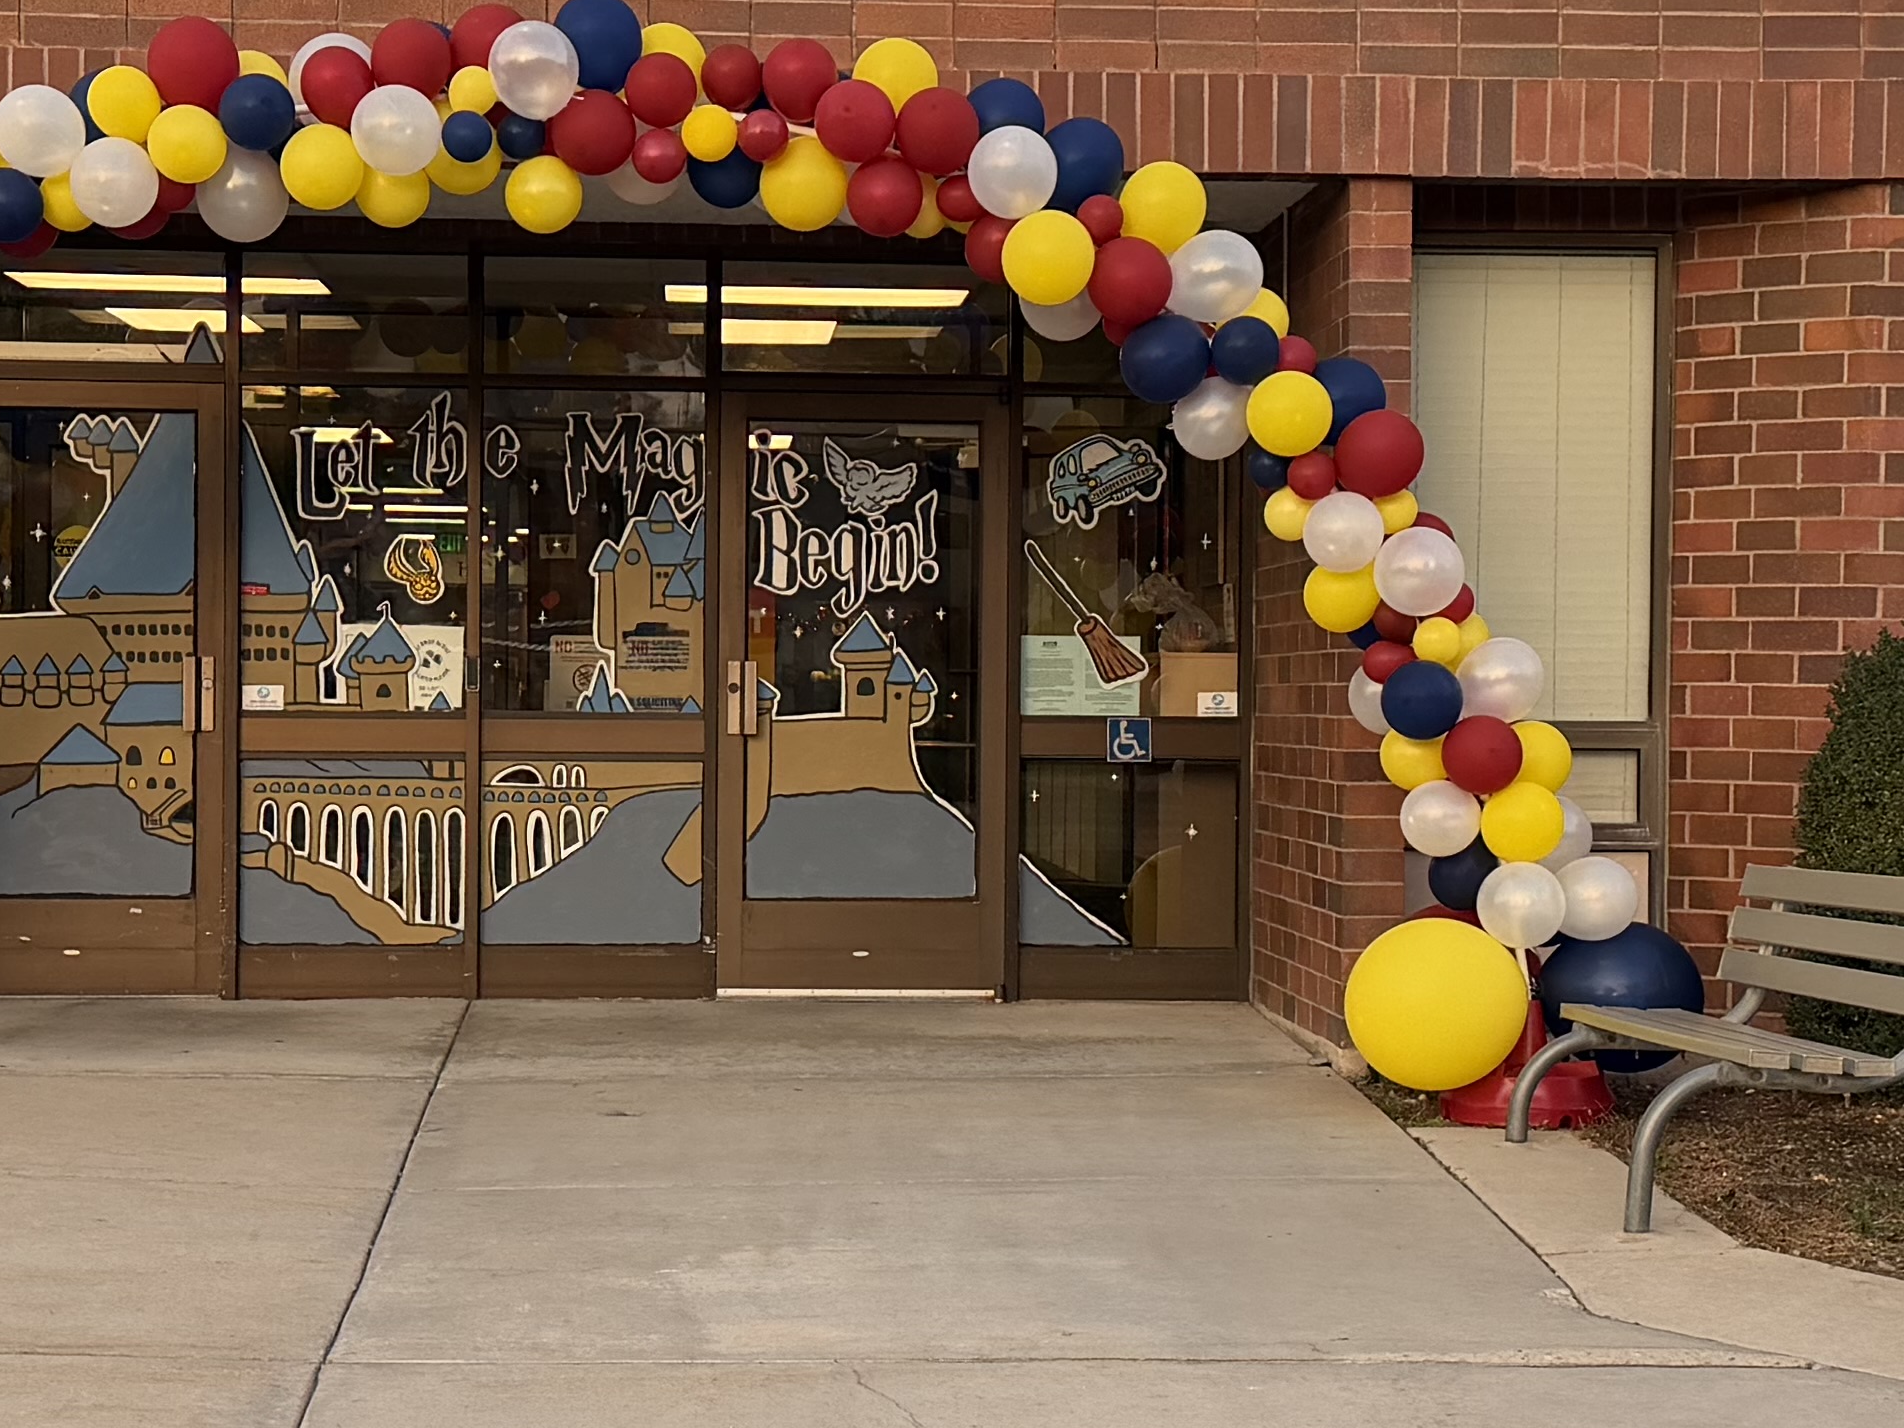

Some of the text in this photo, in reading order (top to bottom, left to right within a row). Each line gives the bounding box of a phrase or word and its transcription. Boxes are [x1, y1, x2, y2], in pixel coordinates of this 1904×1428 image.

[290, 419, 380, 520] Let
[407, 390, 521, 488] the
[752, 489, 939, 618] Begin!
